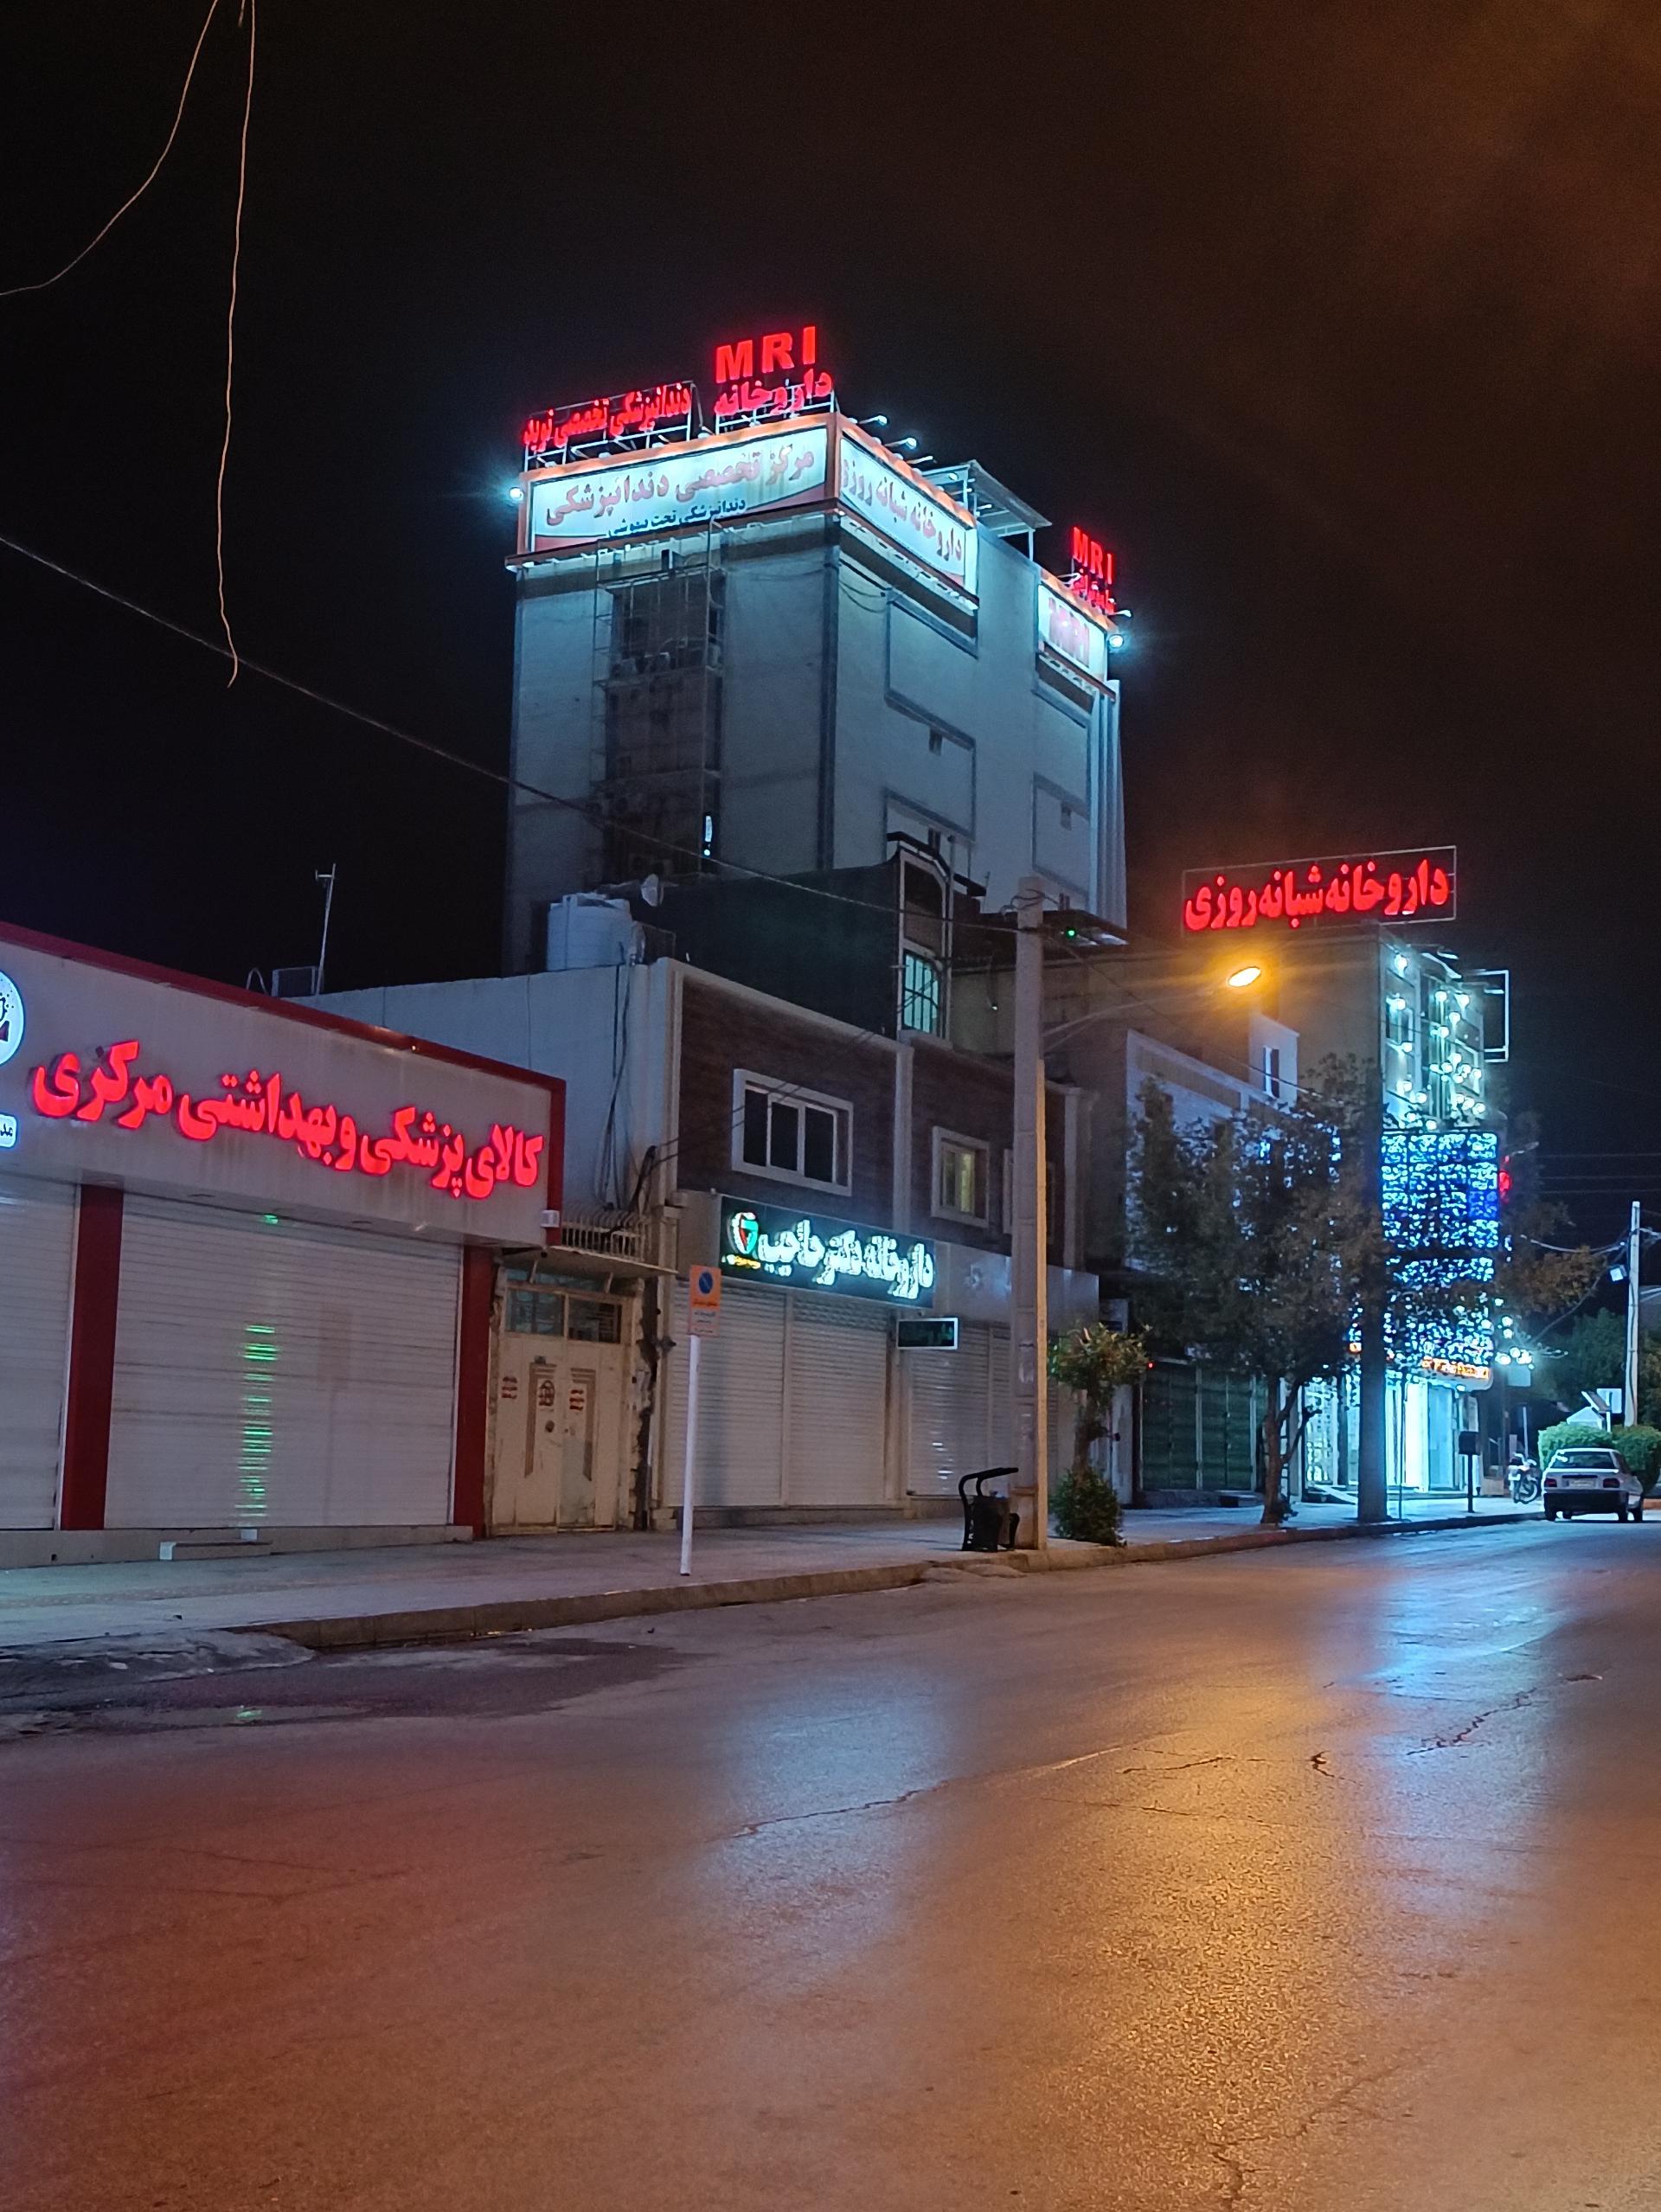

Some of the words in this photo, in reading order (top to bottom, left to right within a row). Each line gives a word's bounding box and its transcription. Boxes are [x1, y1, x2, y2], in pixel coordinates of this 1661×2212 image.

[715, 325, 817, 384] MRI
[608, 382, 692, 437] دندانپزشکی
[714, 368, 833, 416] داروخانه
[554, 398, 610, 449] تخصصی
[676, 451, 761, 503] تخصصی
[766, 443, 815, 486] مرکز
[841, 458, 873, 507] روزی
[546, 471, 670, 527] دندانپزشکی
[875, 476, 907, 523] شبانه
[909, 501, 963, 562] داروخانه
[1072, 526, 1113, 586] MRI
[1183, 875, 1258, 932] روزی
[1258, 865, 1324, 929] شبانه
[1325, 858, 1450, 916] داروخانه
[33, 1041, 173, 1129] مرکزی
[359, 1106, 465, 1198] پزشکی
[465, 1123, 544, 1199] کالای
[863, 1235, 933, 1299] داروخانه
